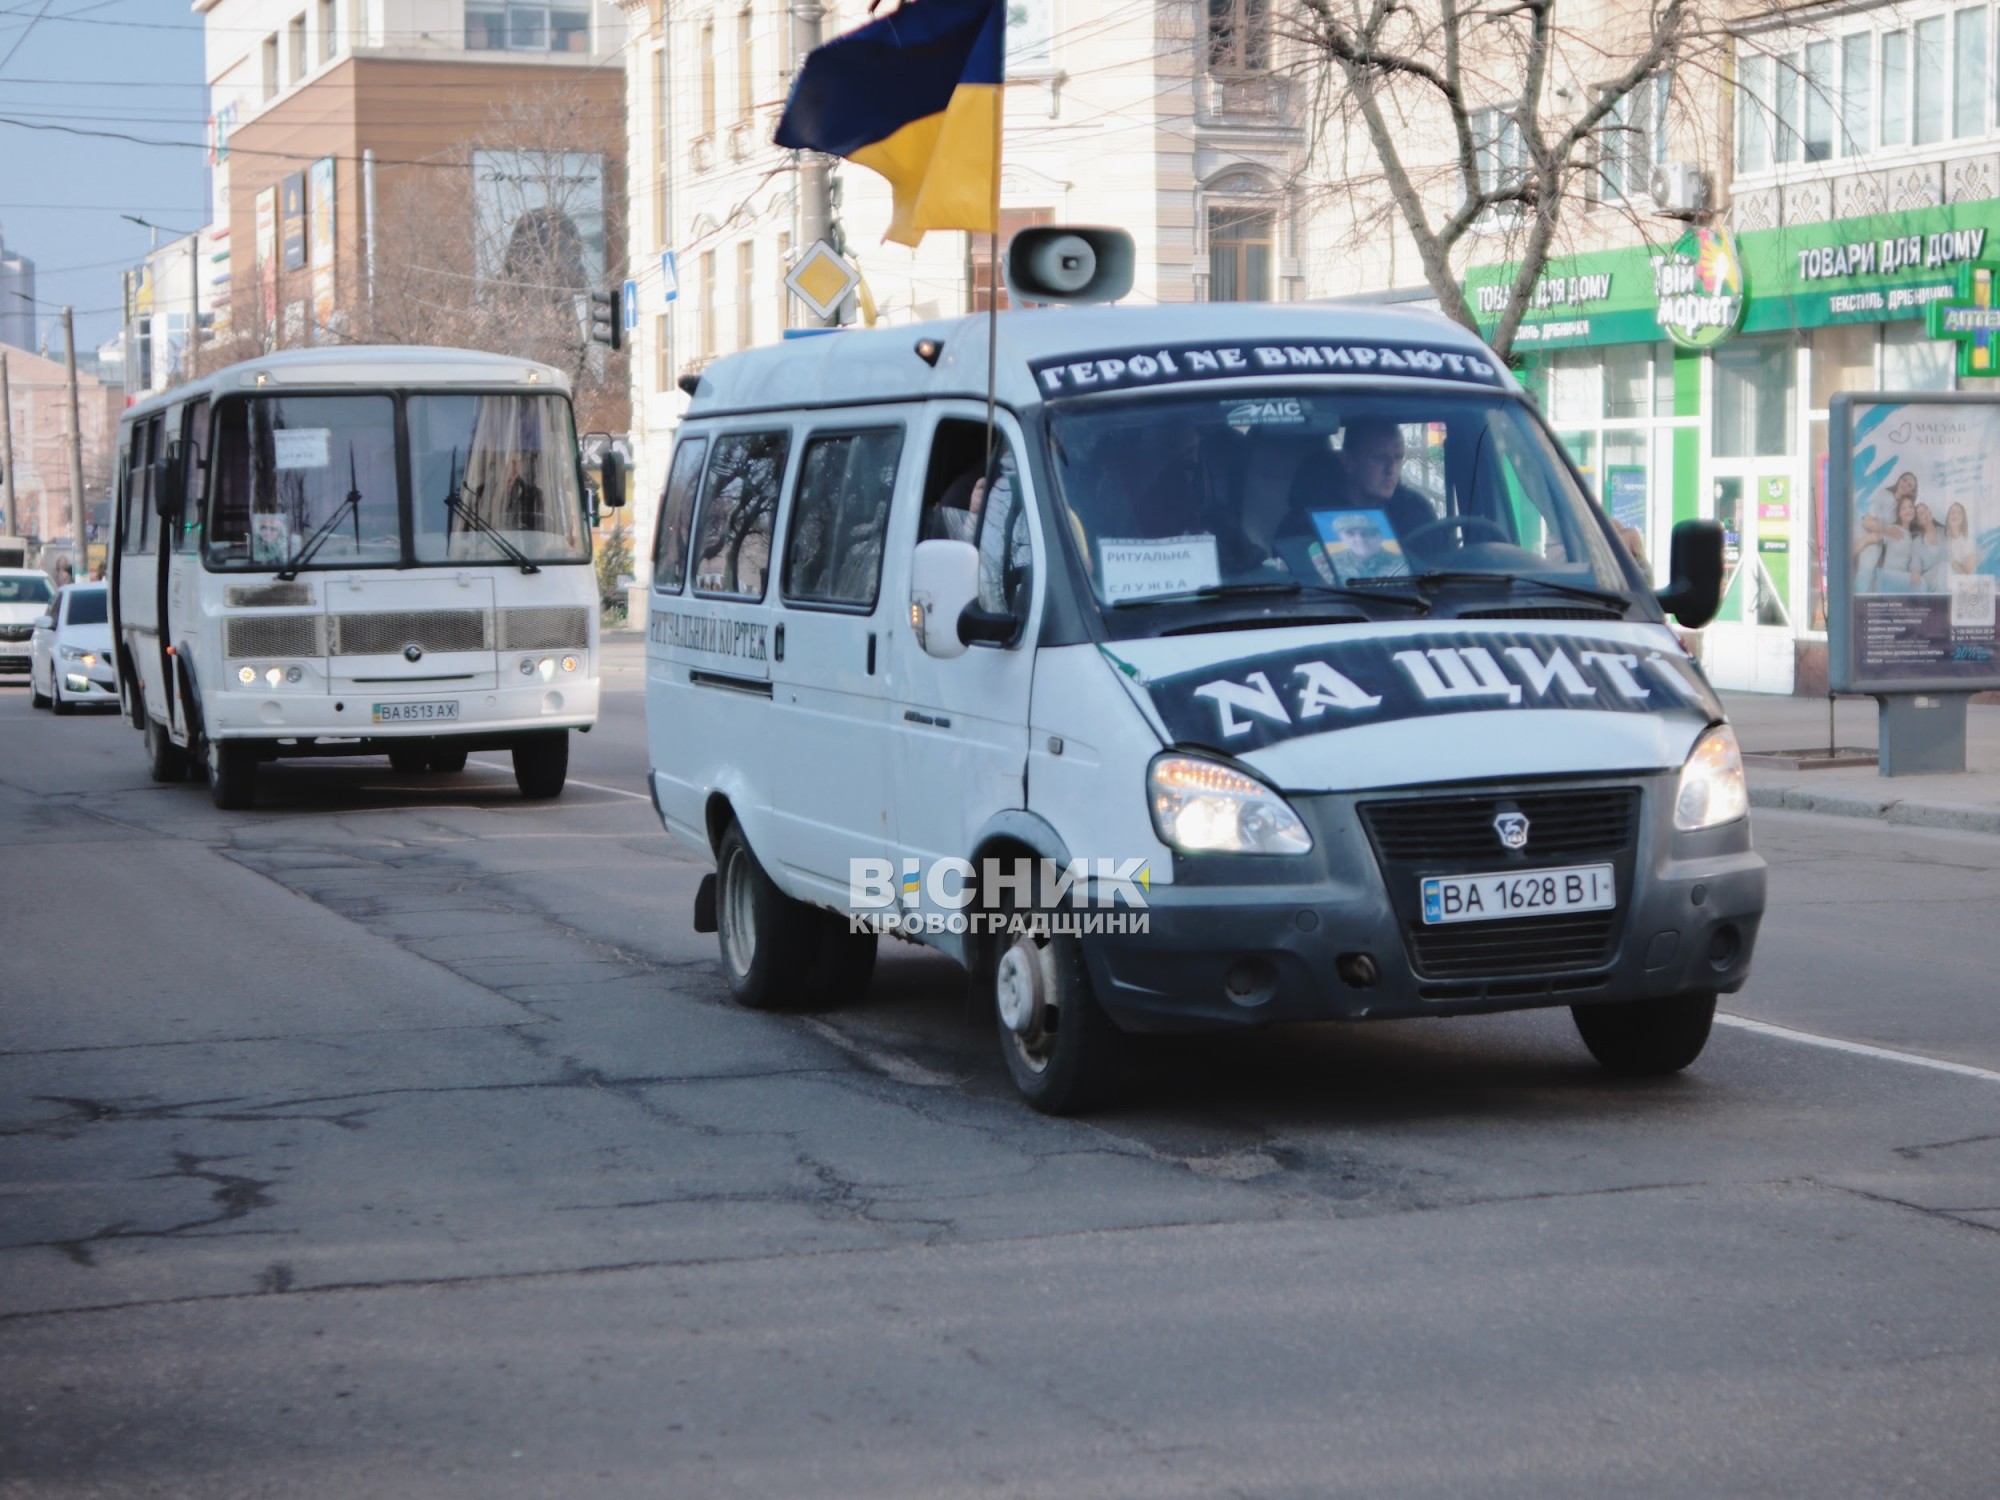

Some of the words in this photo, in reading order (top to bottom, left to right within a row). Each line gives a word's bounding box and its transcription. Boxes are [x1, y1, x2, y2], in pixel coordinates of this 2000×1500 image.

[1798, 241, 1876, 280] ТОВАРИ
[1880, 235, 1922, 273] ДЛЯ
[1927, 228, 1985, 268] ДОМУ
[1536, 278, 1565, 309] ДЛЯ
[1568, 273, 1611, 306] ДОМУ
[1830, 291, 1884, 313] ТЕКСТИЛЬ
[1656, 296, 1732, 338] маркет
[1039, 349, 1178, 390] ГЕРОЇ
[1253, 346, 1495, 378] ВМИРАЮТЬ
[1916, 423, 1967, 433] MALYAR
[1917, 435, 1961, 445] STUDIO
[1106, 549, 1192, 563] РИТУАЛЬНА
[1108, 579, 1188, 594] СЛУЖБА
[718, 618, 768, 661] КОРТЕЖ
[403, 705, 433, 719] 8513
[1443, 883, 1484, 914] BA
[1495, 877, 1557, 910] 1628
